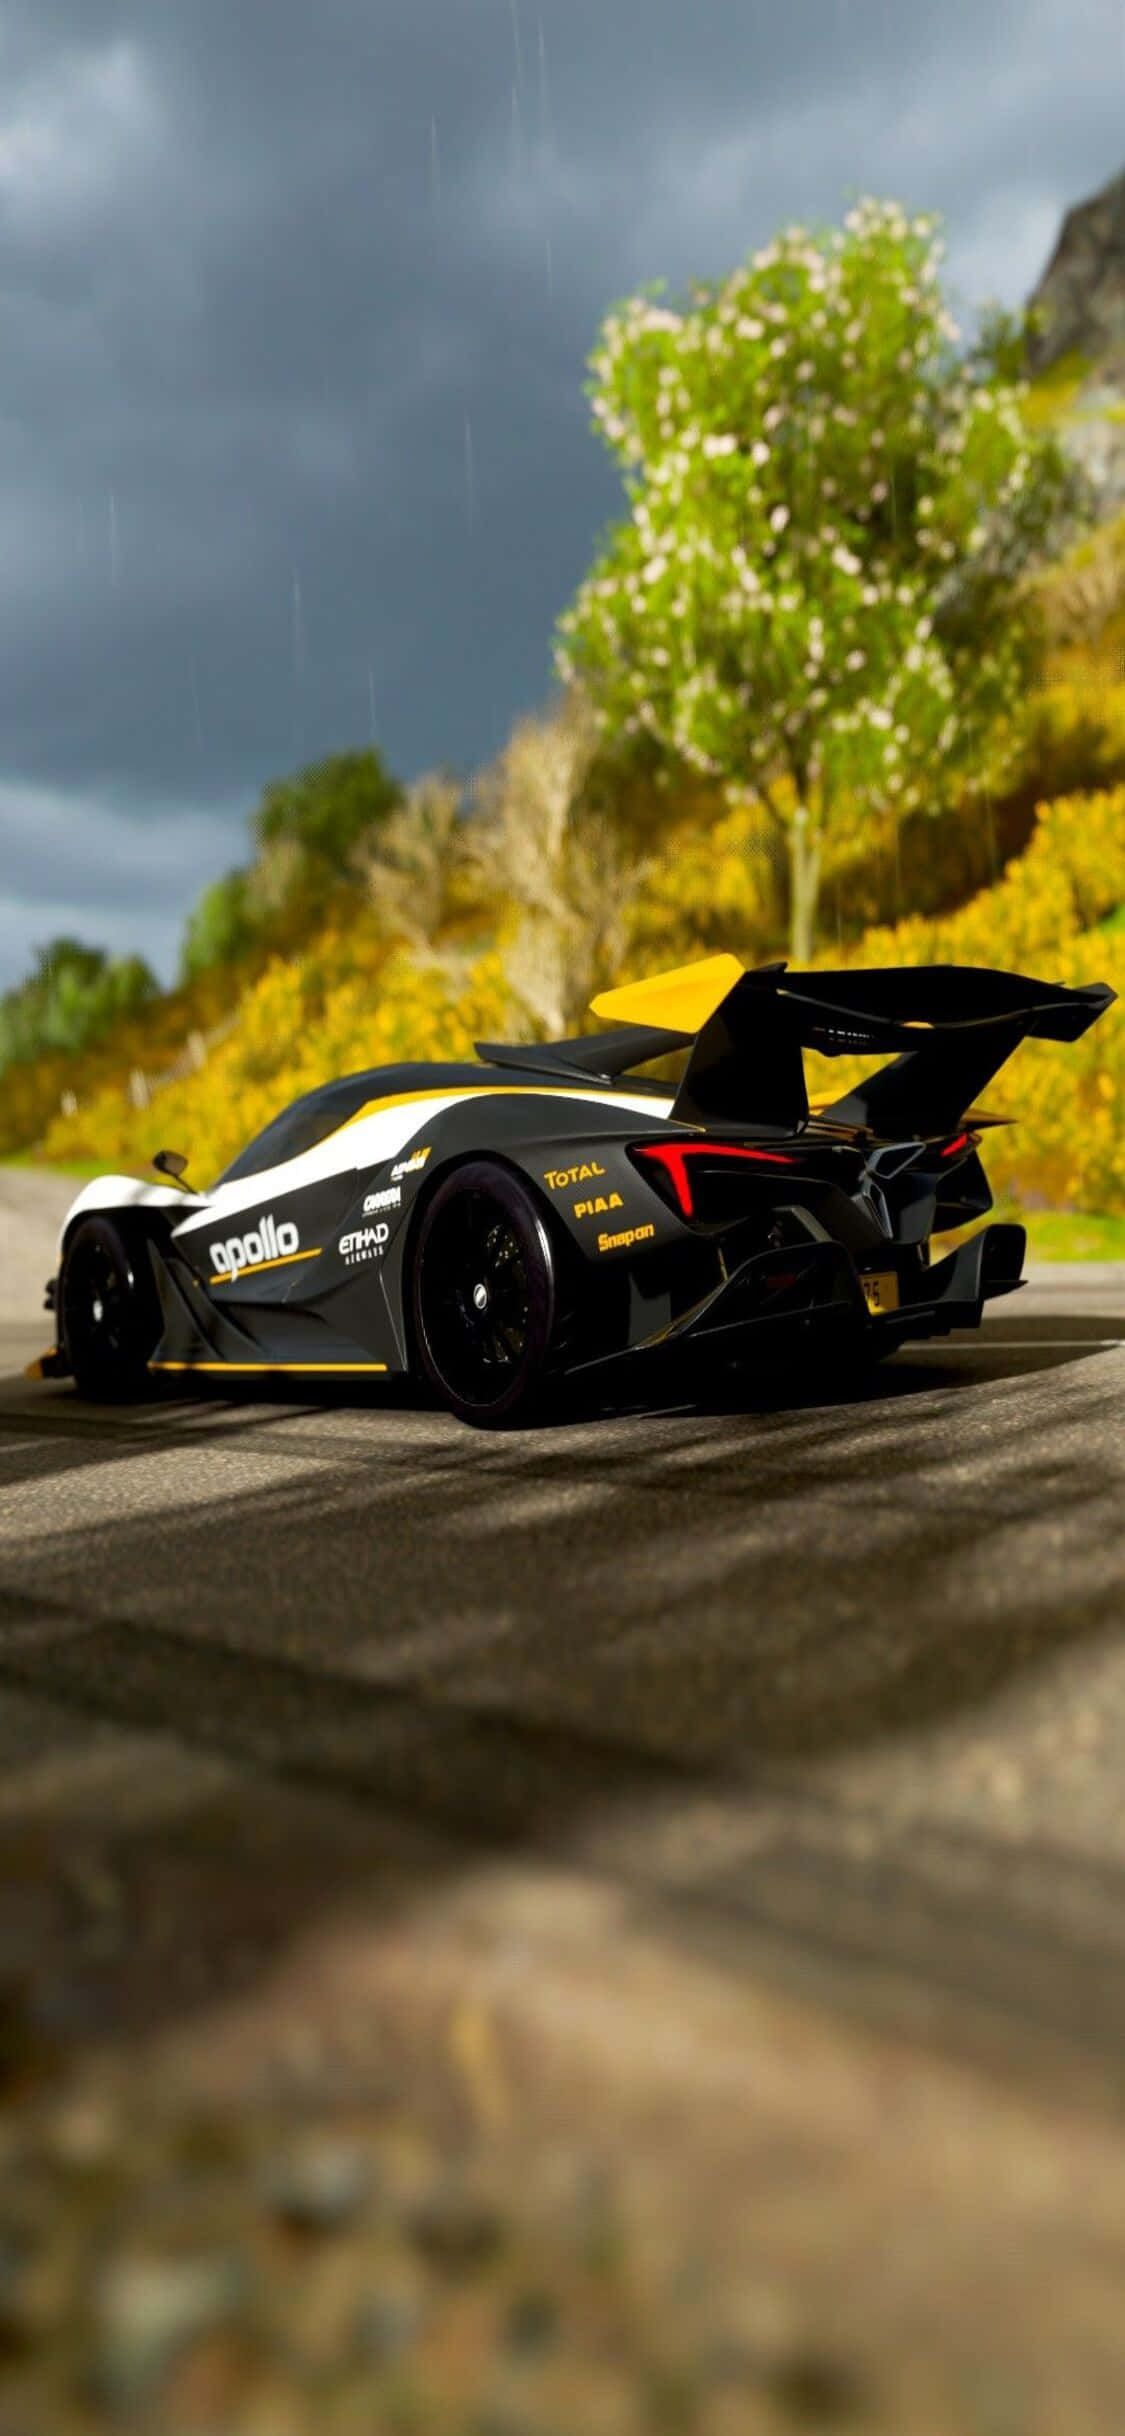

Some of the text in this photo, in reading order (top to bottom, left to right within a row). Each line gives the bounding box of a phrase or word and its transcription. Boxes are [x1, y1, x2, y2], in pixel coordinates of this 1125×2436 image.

[574, 1192, 624, 1218] PIAA
[209, 1213, 299, 1282] apollo
[339, 1222, 389, 1254] ETIHAD
